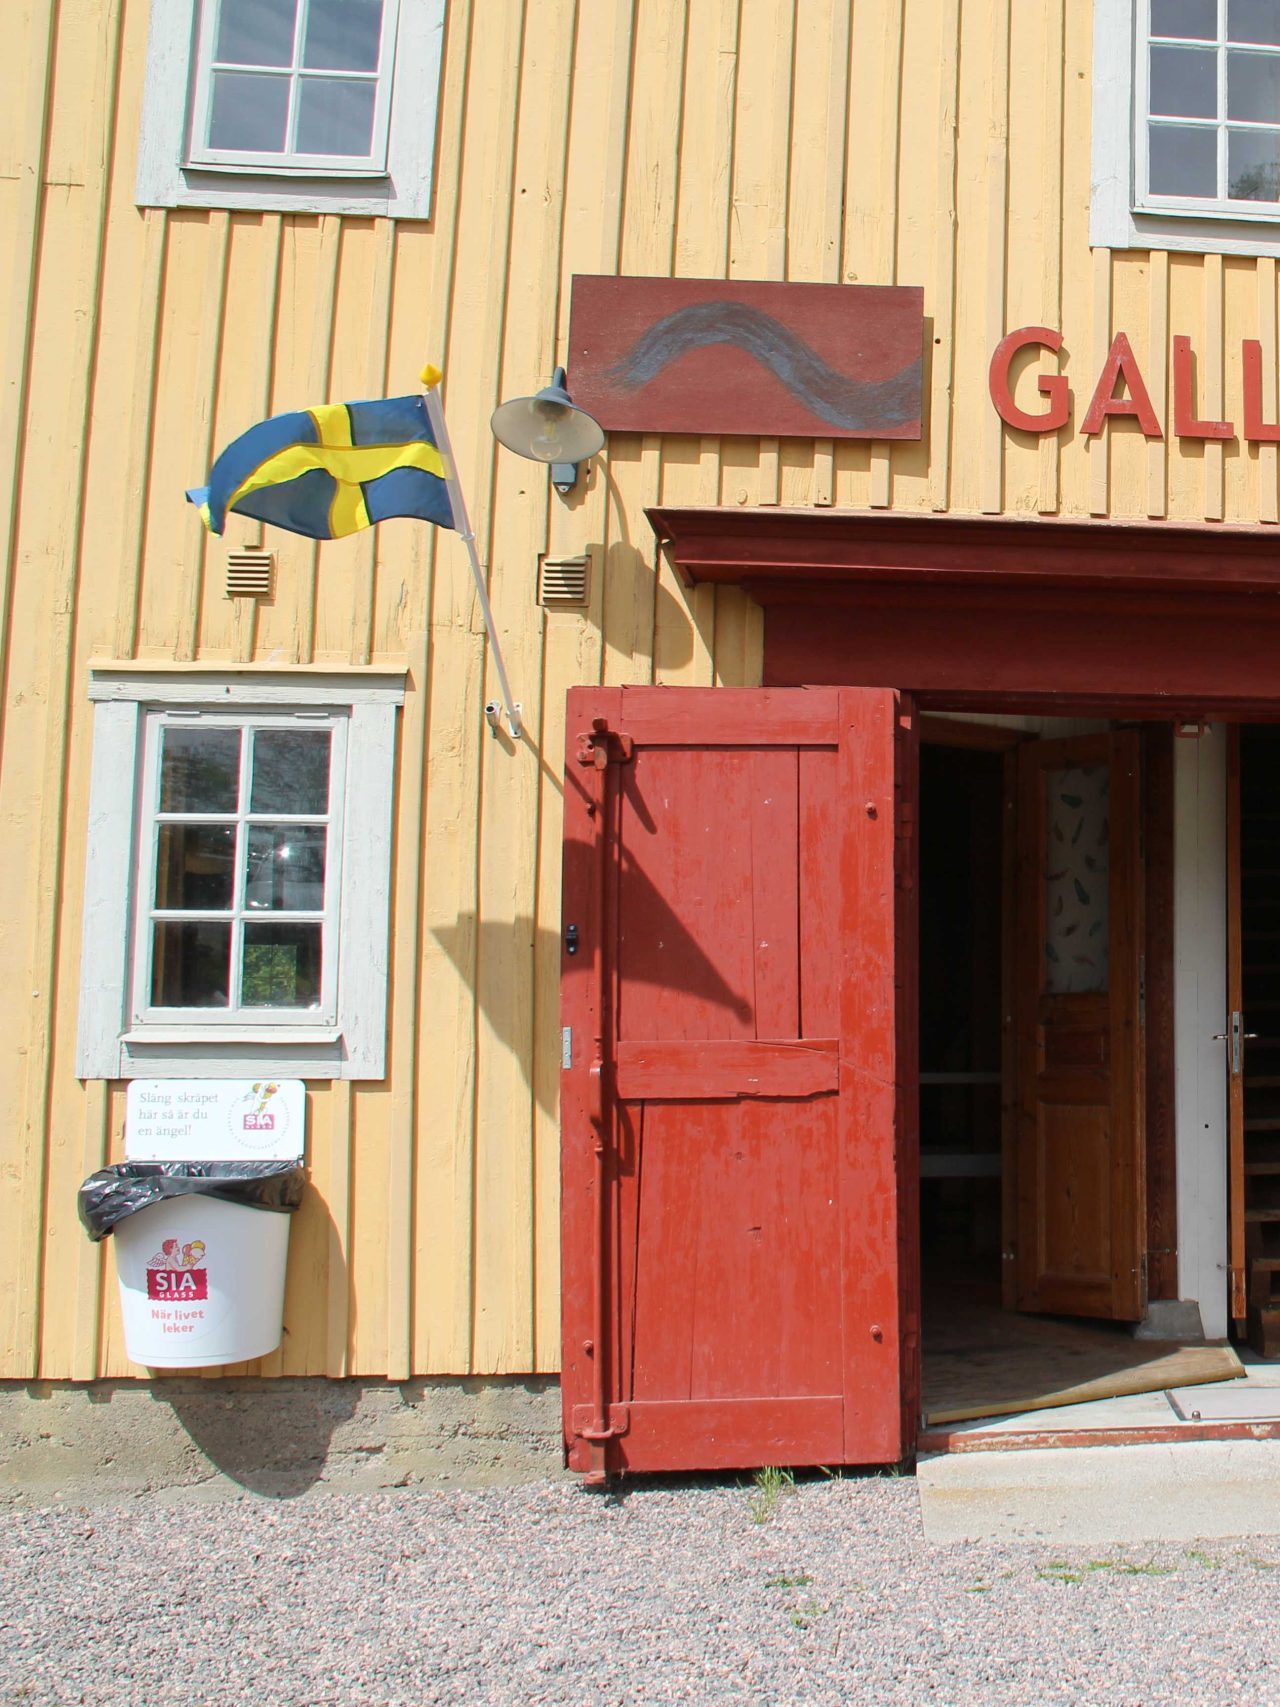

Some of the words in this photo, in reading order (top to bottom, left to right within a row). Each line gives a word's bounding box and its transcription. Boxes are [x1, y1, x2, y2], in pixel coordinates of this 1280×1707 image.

[140, 1092, 172, 1105] Släng
[177, 1092, 219, 1105] skräpet
[138, 1109, 157, 1120] här
[162, 1109, 174, 1120] så
[178, 1109, 190, 1120] är
[192, 1108, 208, 1120] du
[245, 1115, 273, 1126] SIA
[138, 1127, 152, 1136] en
[156, 1124, 192, 1138] ängel!
[155, 1272, 197, 1291] SIA
[151, 1309, 172, 1319] När
[174, 1309, 205, 1320] livet
[163, 1323, 194, 1333] leker
